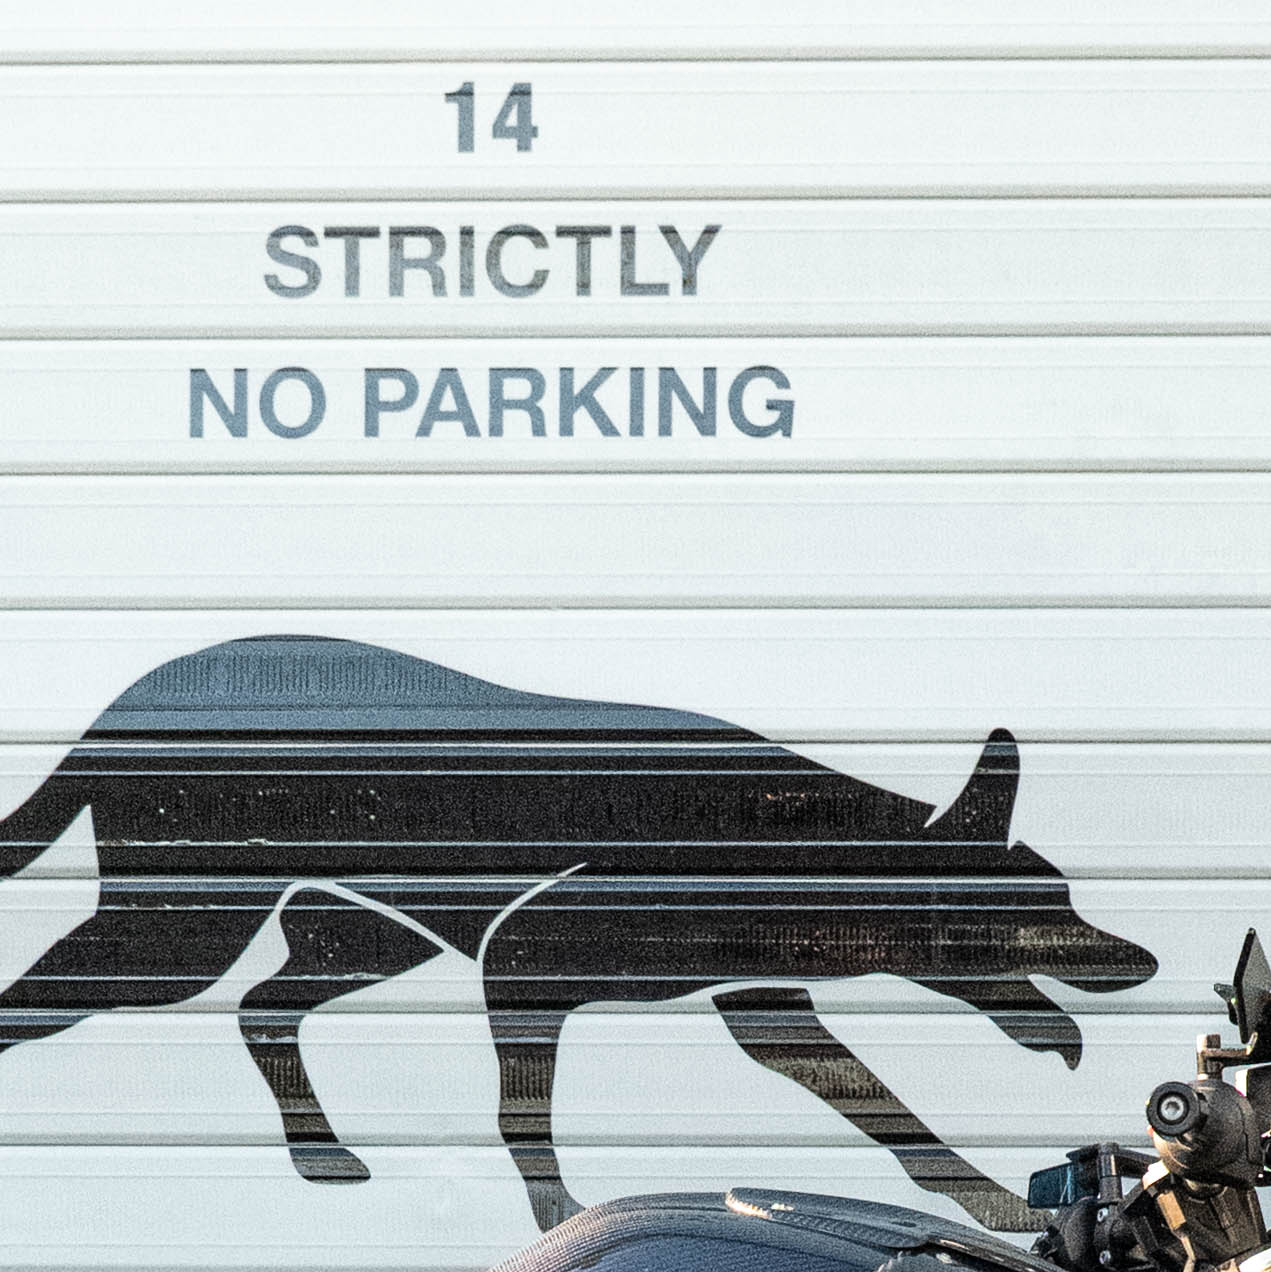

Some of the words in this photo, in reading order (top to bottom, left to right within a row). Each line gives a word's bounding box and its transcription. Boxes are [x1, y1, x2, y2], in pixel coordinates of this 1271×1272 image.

[444, 81, 539, 153] 14
[263, 224, 723, 299] STRICTLY
[188, 365, 327, 440] NO
[363, 365, 796, 440] PARKING
